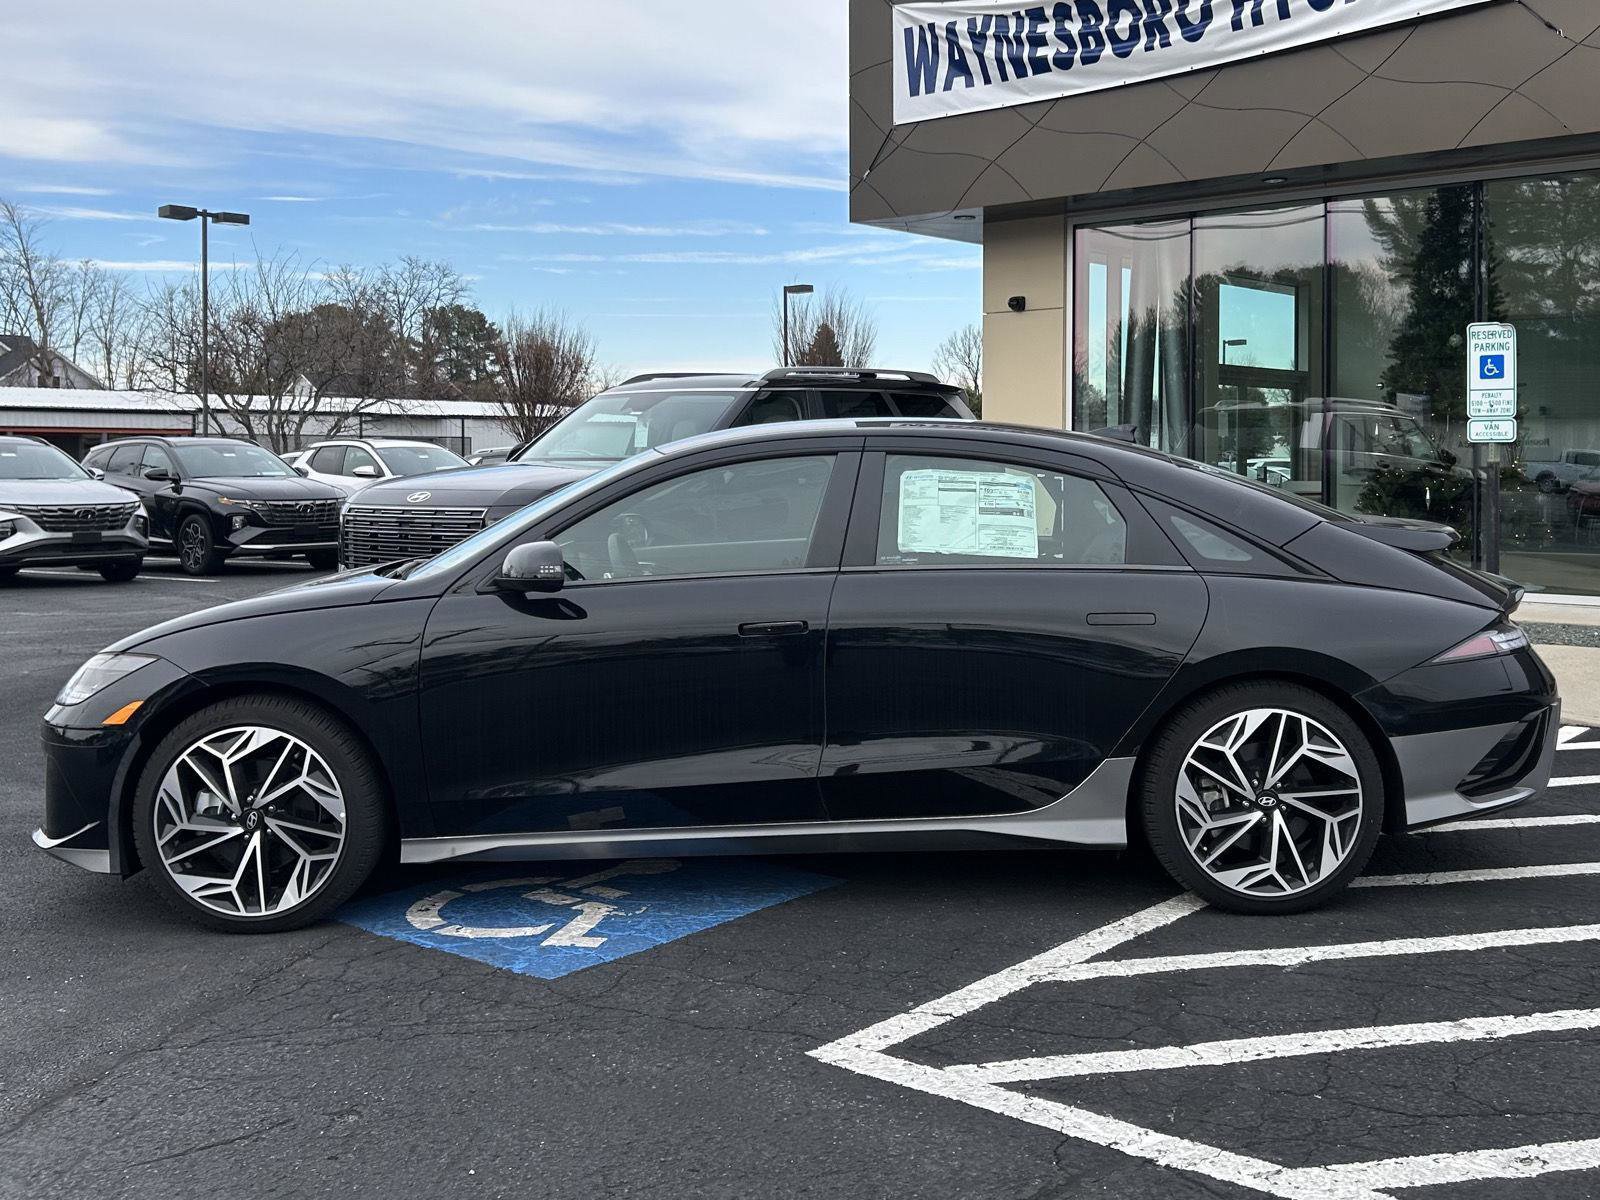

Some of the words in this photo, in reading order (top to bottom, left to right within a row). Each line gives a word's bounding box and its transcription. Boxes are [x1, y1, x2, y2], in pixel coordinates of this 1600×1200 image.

[904, 0, 1213, 97] WAYNESBORO
[1471, 330, 1513, 340] RESERVED
[1473, 342, 1510, 352] PARKING
[1483, 423, 1500, 431] VAN
